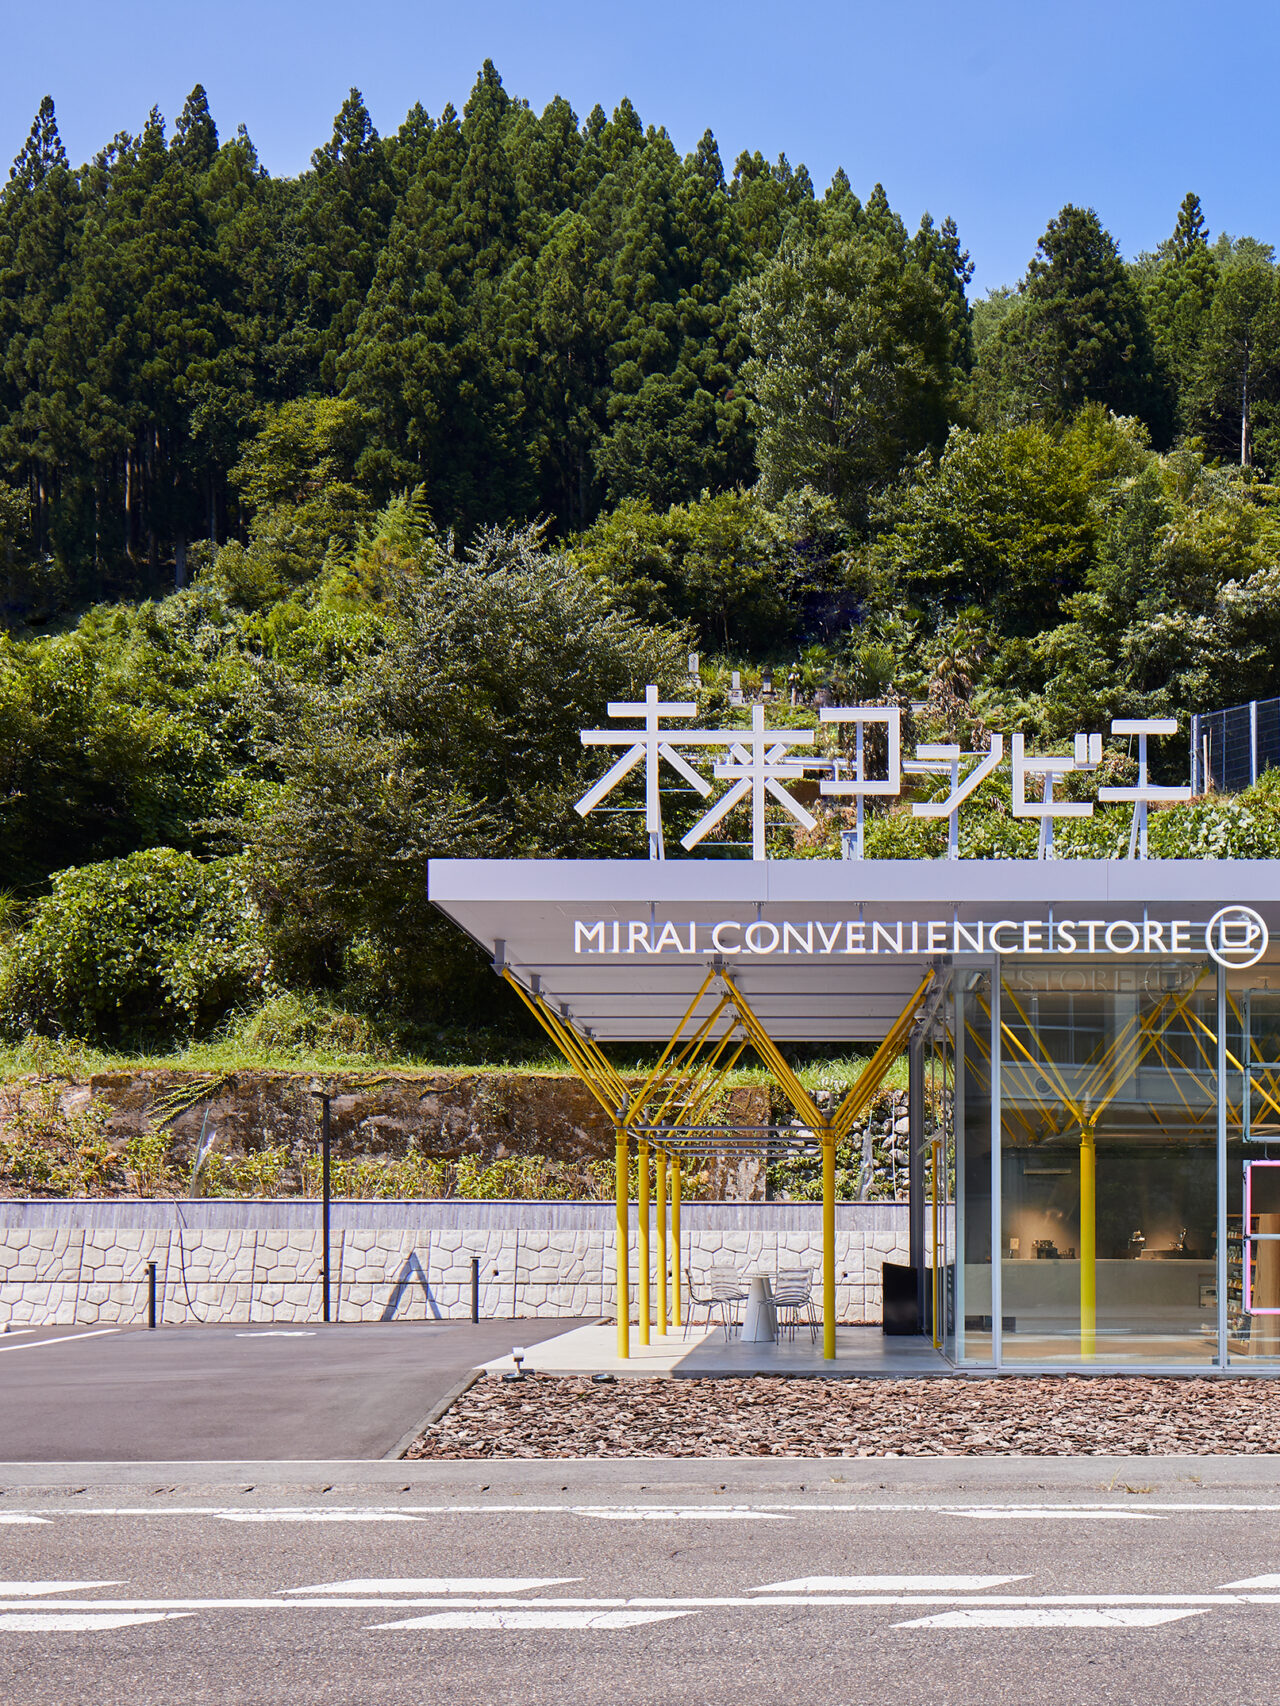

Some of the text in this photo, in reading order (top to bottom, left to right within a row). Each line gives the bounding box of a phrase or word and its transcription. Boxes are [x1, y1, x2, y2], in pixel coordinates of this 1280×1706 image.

[573, 684, 1192, 861] 未来コンビニ
[574, 920, 1192, 954] MIRAI CONVENIENCE STORE
